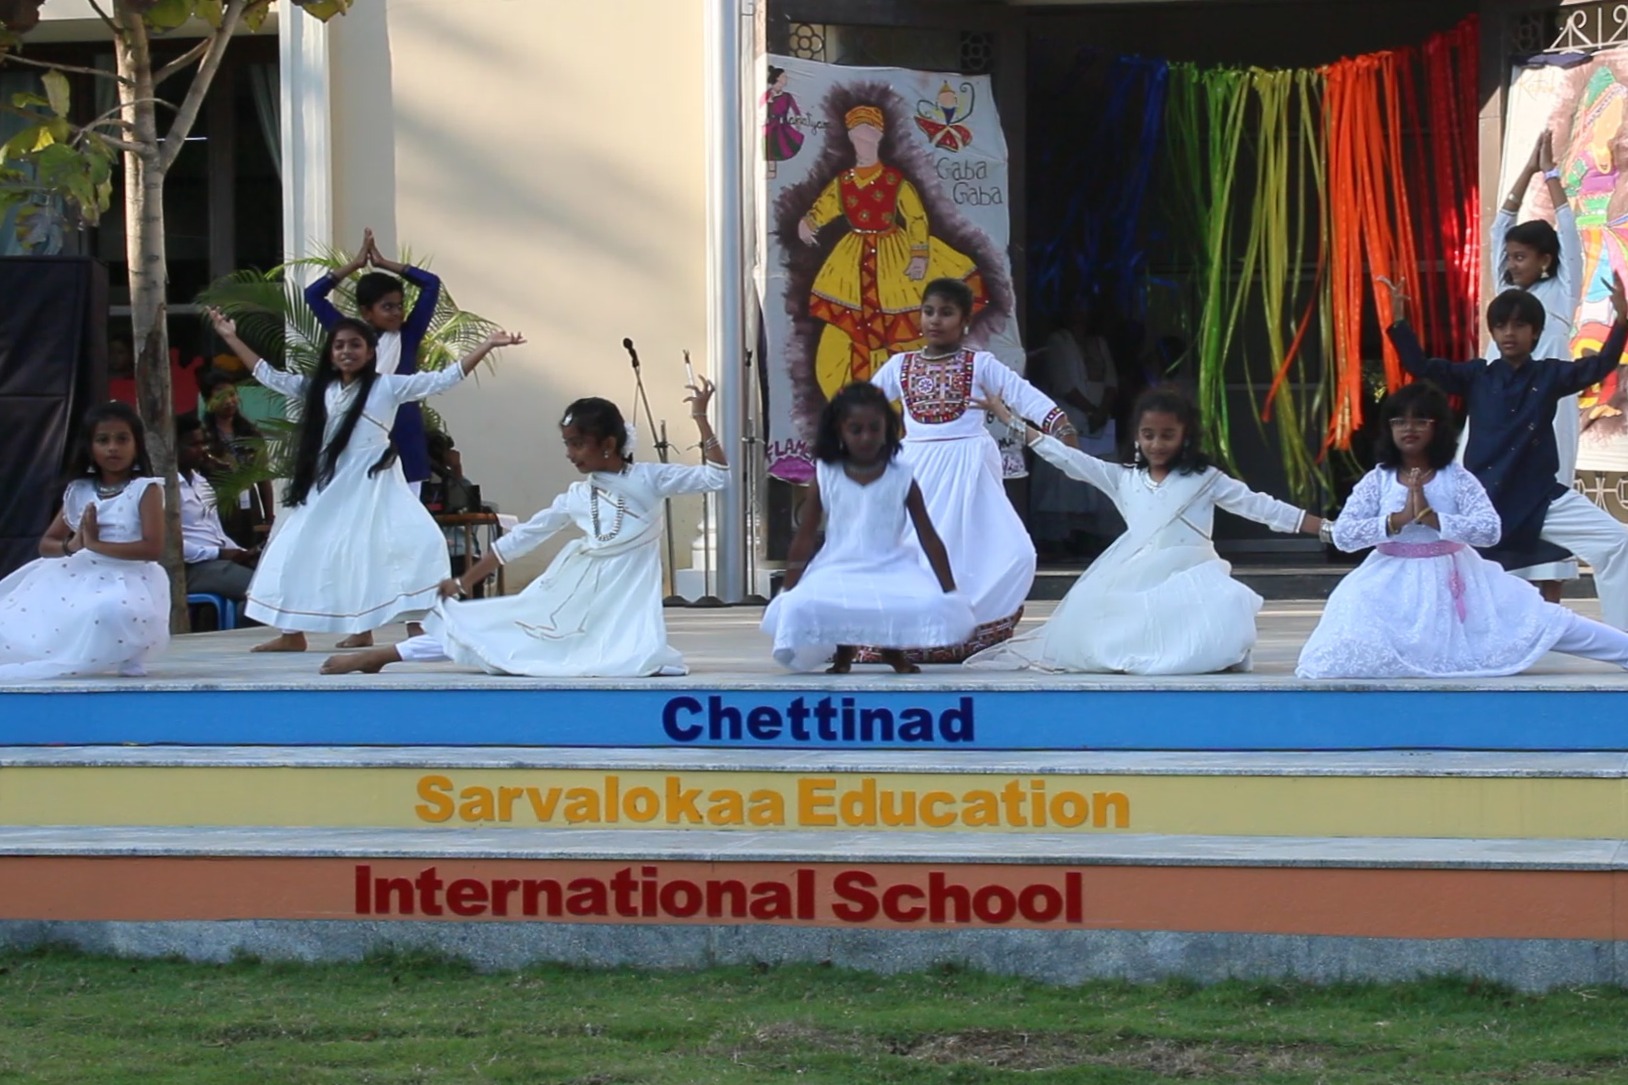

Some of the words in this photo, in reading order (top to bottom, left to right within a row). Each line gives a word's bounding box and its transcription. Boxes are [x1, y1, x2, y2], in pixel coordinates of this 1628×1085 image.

[935, 156, 988, 181] Gaba
[952, 181, 1003, 206] Gaba
[661, 695, 975, 743] Chettinad
[414, 774, 786, 826] Sarvalokaa
[797, 777, 1130, 829] Education
[354, 864, 816, 921] International
[831, 869, 1084, 924] School
